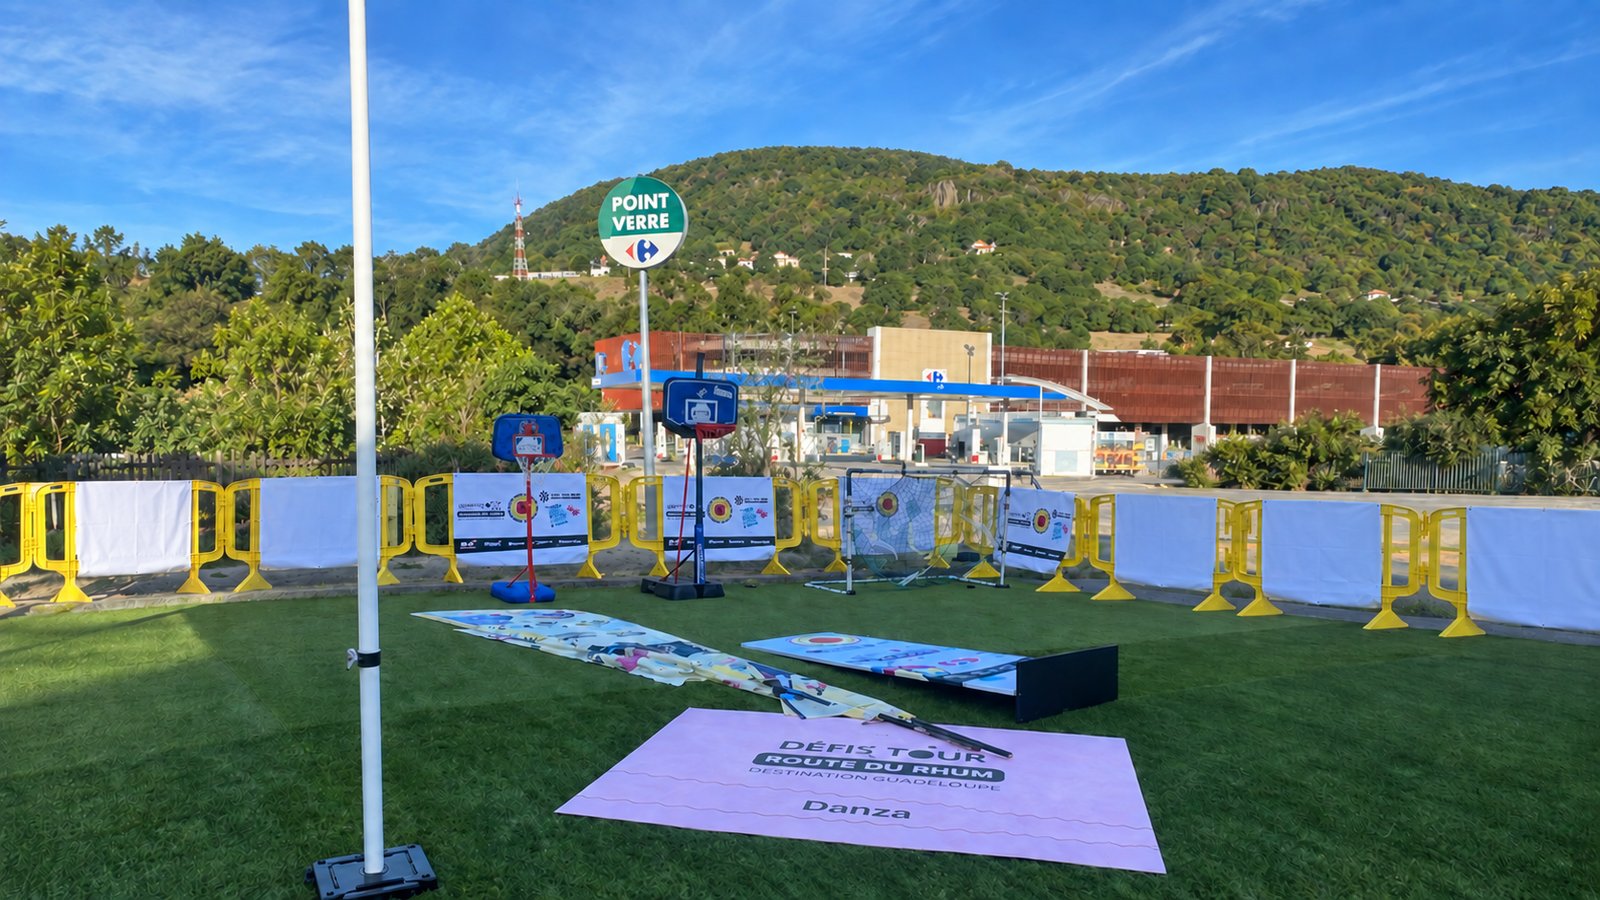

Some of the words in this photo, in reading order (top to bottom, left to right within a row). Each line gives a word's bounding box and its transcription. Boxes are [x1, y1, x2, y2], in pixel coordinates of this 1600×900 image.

[612, 193, 669, 212] POINT
[612, 213, 669, 231] VERRE
[779, 741, 876, 756] DÉFIS
[887, 747, 986, 763] TOUR
[765, 756, 857, 769] ROUTE
[864, 762, 904, 772] DU
[912, 765, 993, 779] RHUM
[749, 767, 868, 781] DESTINATION
[873, 776, 1001, 791] GUADELOUPE
[803, 800, 911, 819] Danza
